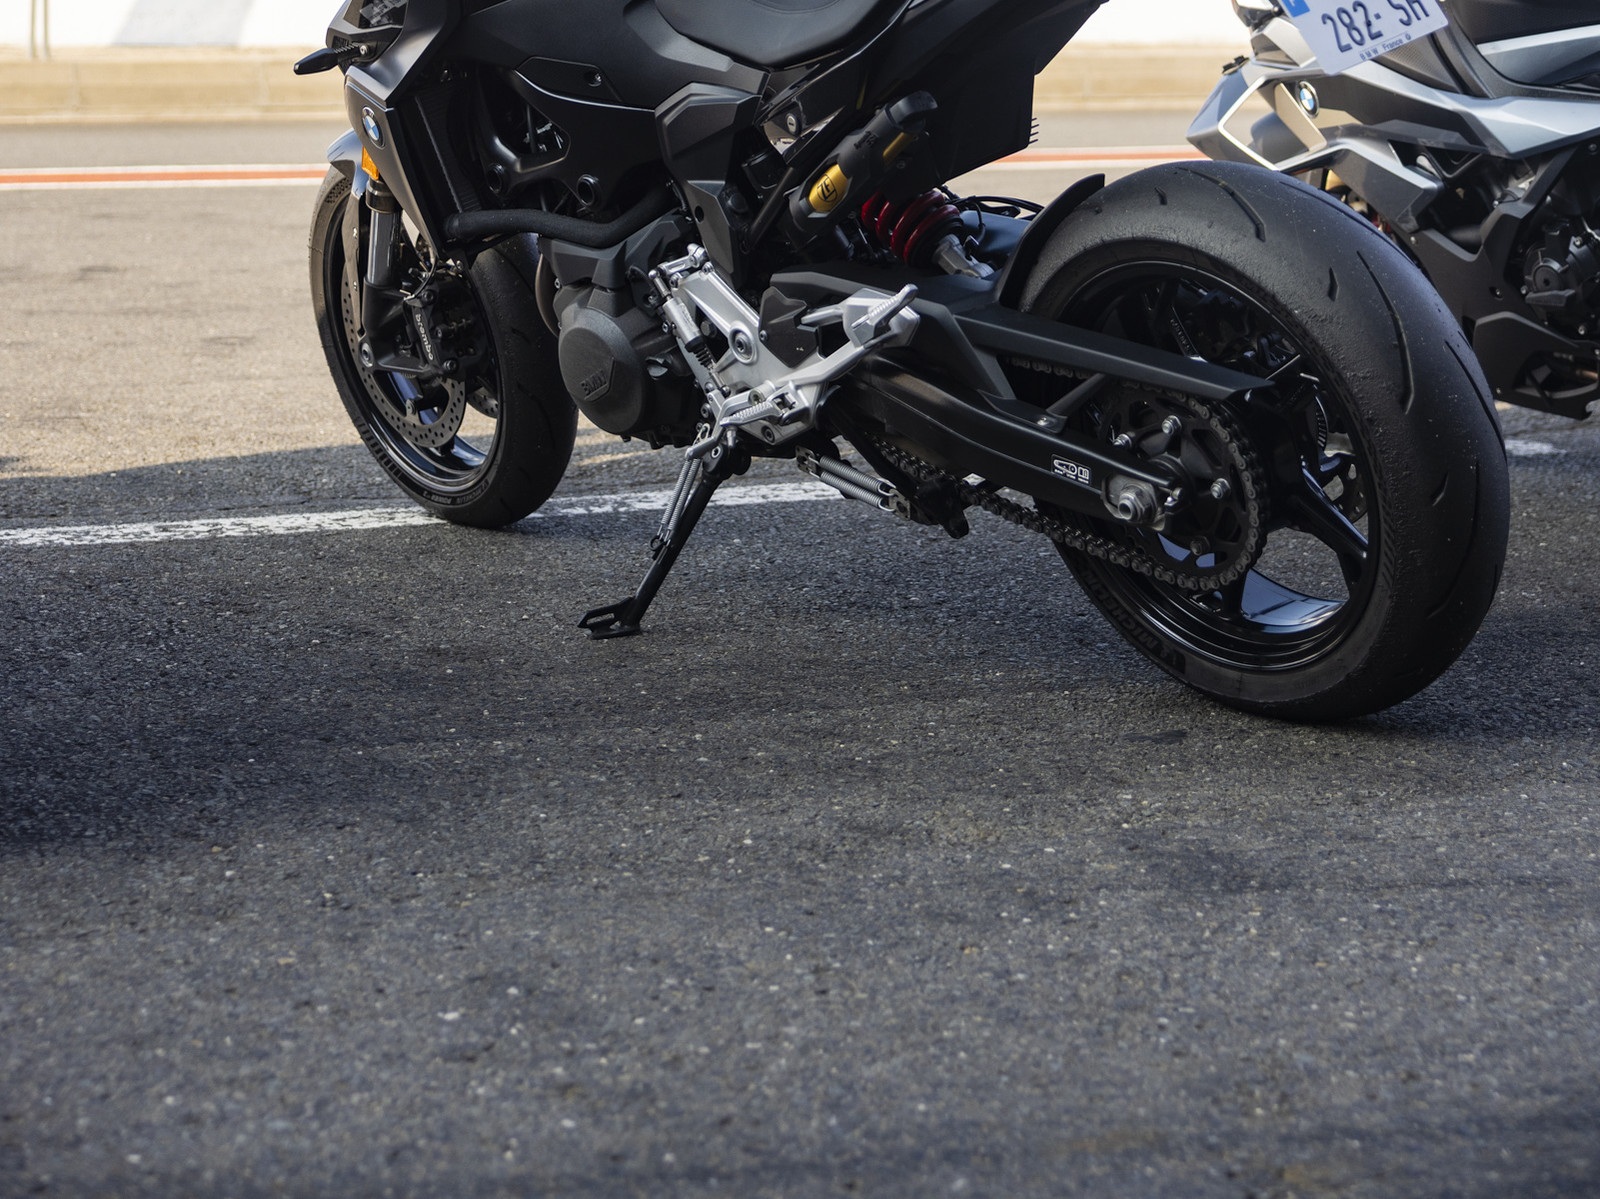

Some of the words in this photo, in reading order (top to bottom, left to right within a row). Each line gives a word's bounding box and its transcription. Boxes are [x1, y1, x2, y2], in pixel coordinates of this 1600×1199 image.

[1382, 38, 1404, 51] France
[817, 180, 837, 201] ZF
[415, 313, 434, 361] brembo
[579, 368, 608, 397] BMW
